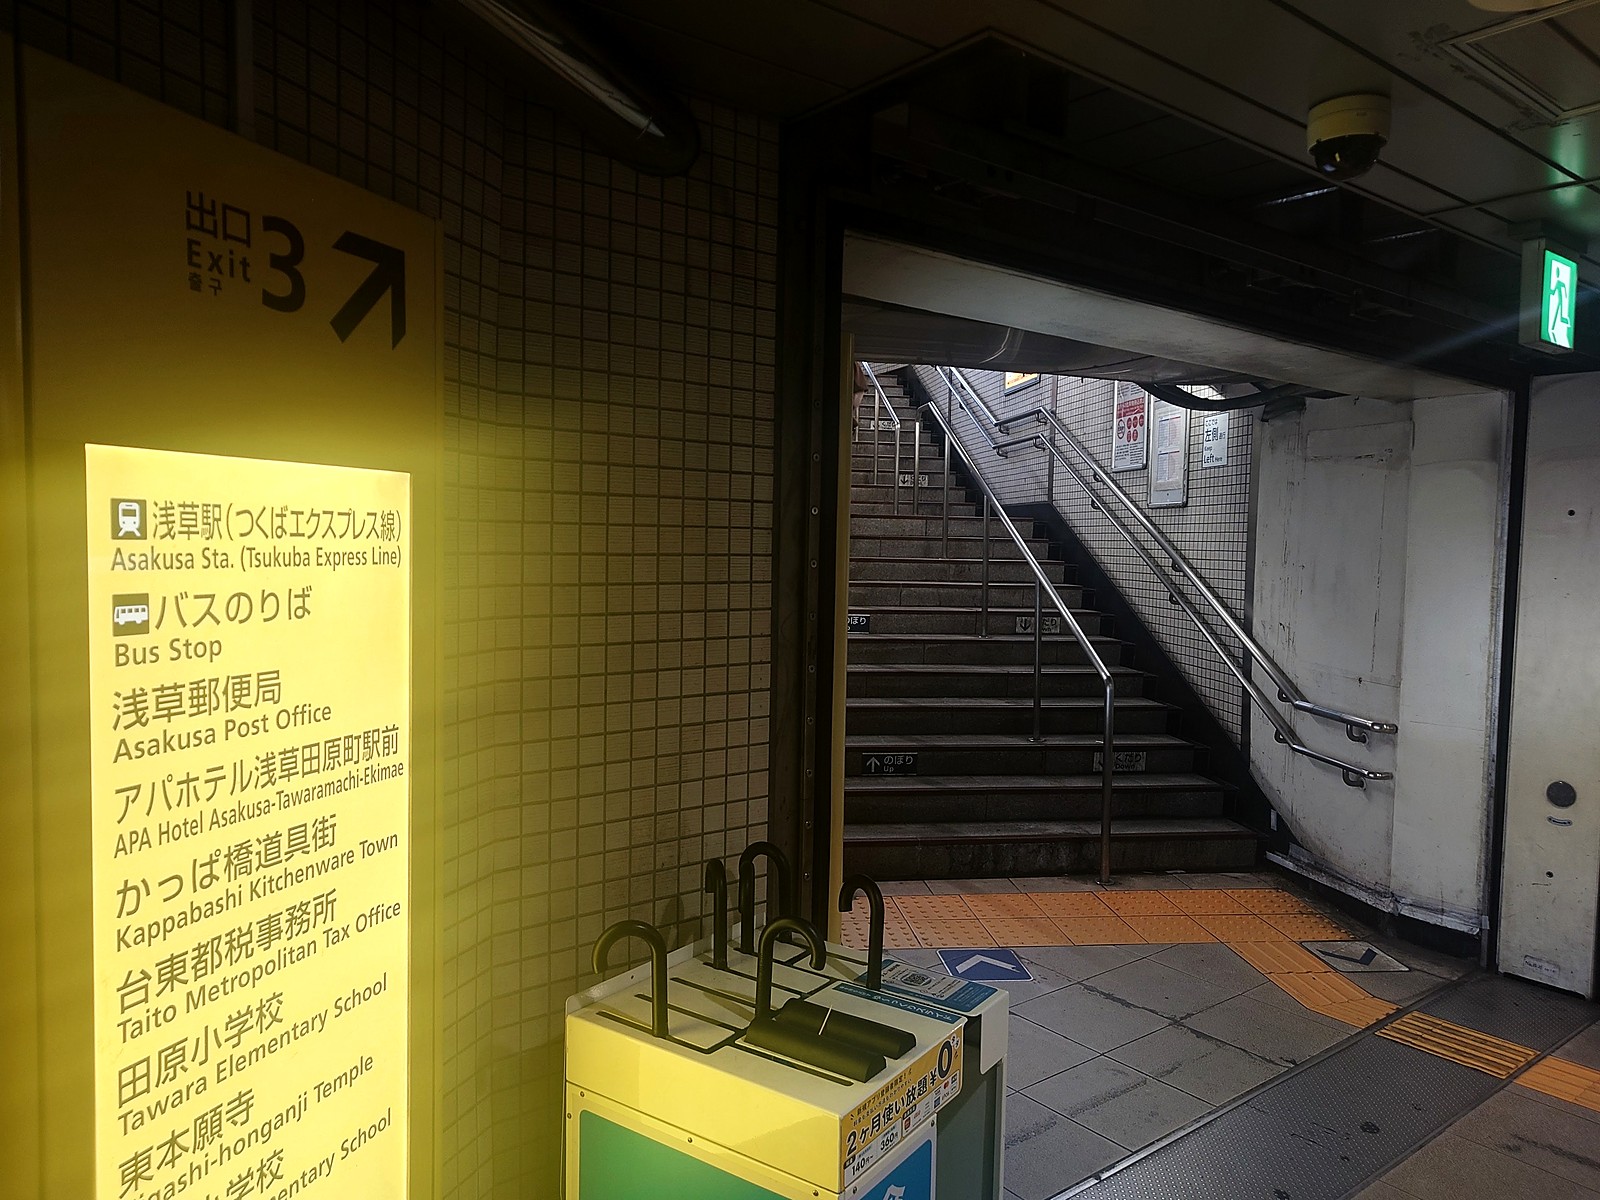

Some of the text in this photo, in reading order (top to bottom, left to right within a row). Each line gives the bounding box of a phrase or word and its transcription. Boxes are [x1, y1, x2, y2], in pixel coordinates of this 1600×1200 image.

[186, 190, 250, 248] 出口
[186, 238, 250, 282] Exit
[188, 272, 222, 296] 출구
[262, 215, 305, 313] 3
[1204, 453, 1215, 463] Left
[110, 545, 402, 572] Asakusa Sta. (Tsukuba Express Line)
[154, 585, 313, 630] バスのりば
[848, 616, 867, 625] ぼり
[114, 637, 223, 667] Bus Stop
[112, 669, 283, 732] 浅草郵便局
[112, 703, 332, 764] Asakusa Post Office
[883, 755, 914, 765] のぼり
[114, 723, 400, 825] アパホテル浅草田原町駅前
[113, 760, 404, 859] APA Hotel Asakusa-Tawaramachi-Ekimae
[116, 813, 338, 919] かっぱ橋道具街
[116, 832, 399, 952] Kappabashi Kitchenware Town
[116, 888, 338, 1015] 台東都税事務所
[117, 901, 401, 1044] Taito Metropolitan Tax Office
[117, 991, 285, 1109] 田原小学校
[117, 972, 388, 1137] Tawara Elementary School
[313, 1054, 374, 1102] Temple
[118, 1087, 255, 1199] 東本願寺
[340, 1107, 392, 1160] School
